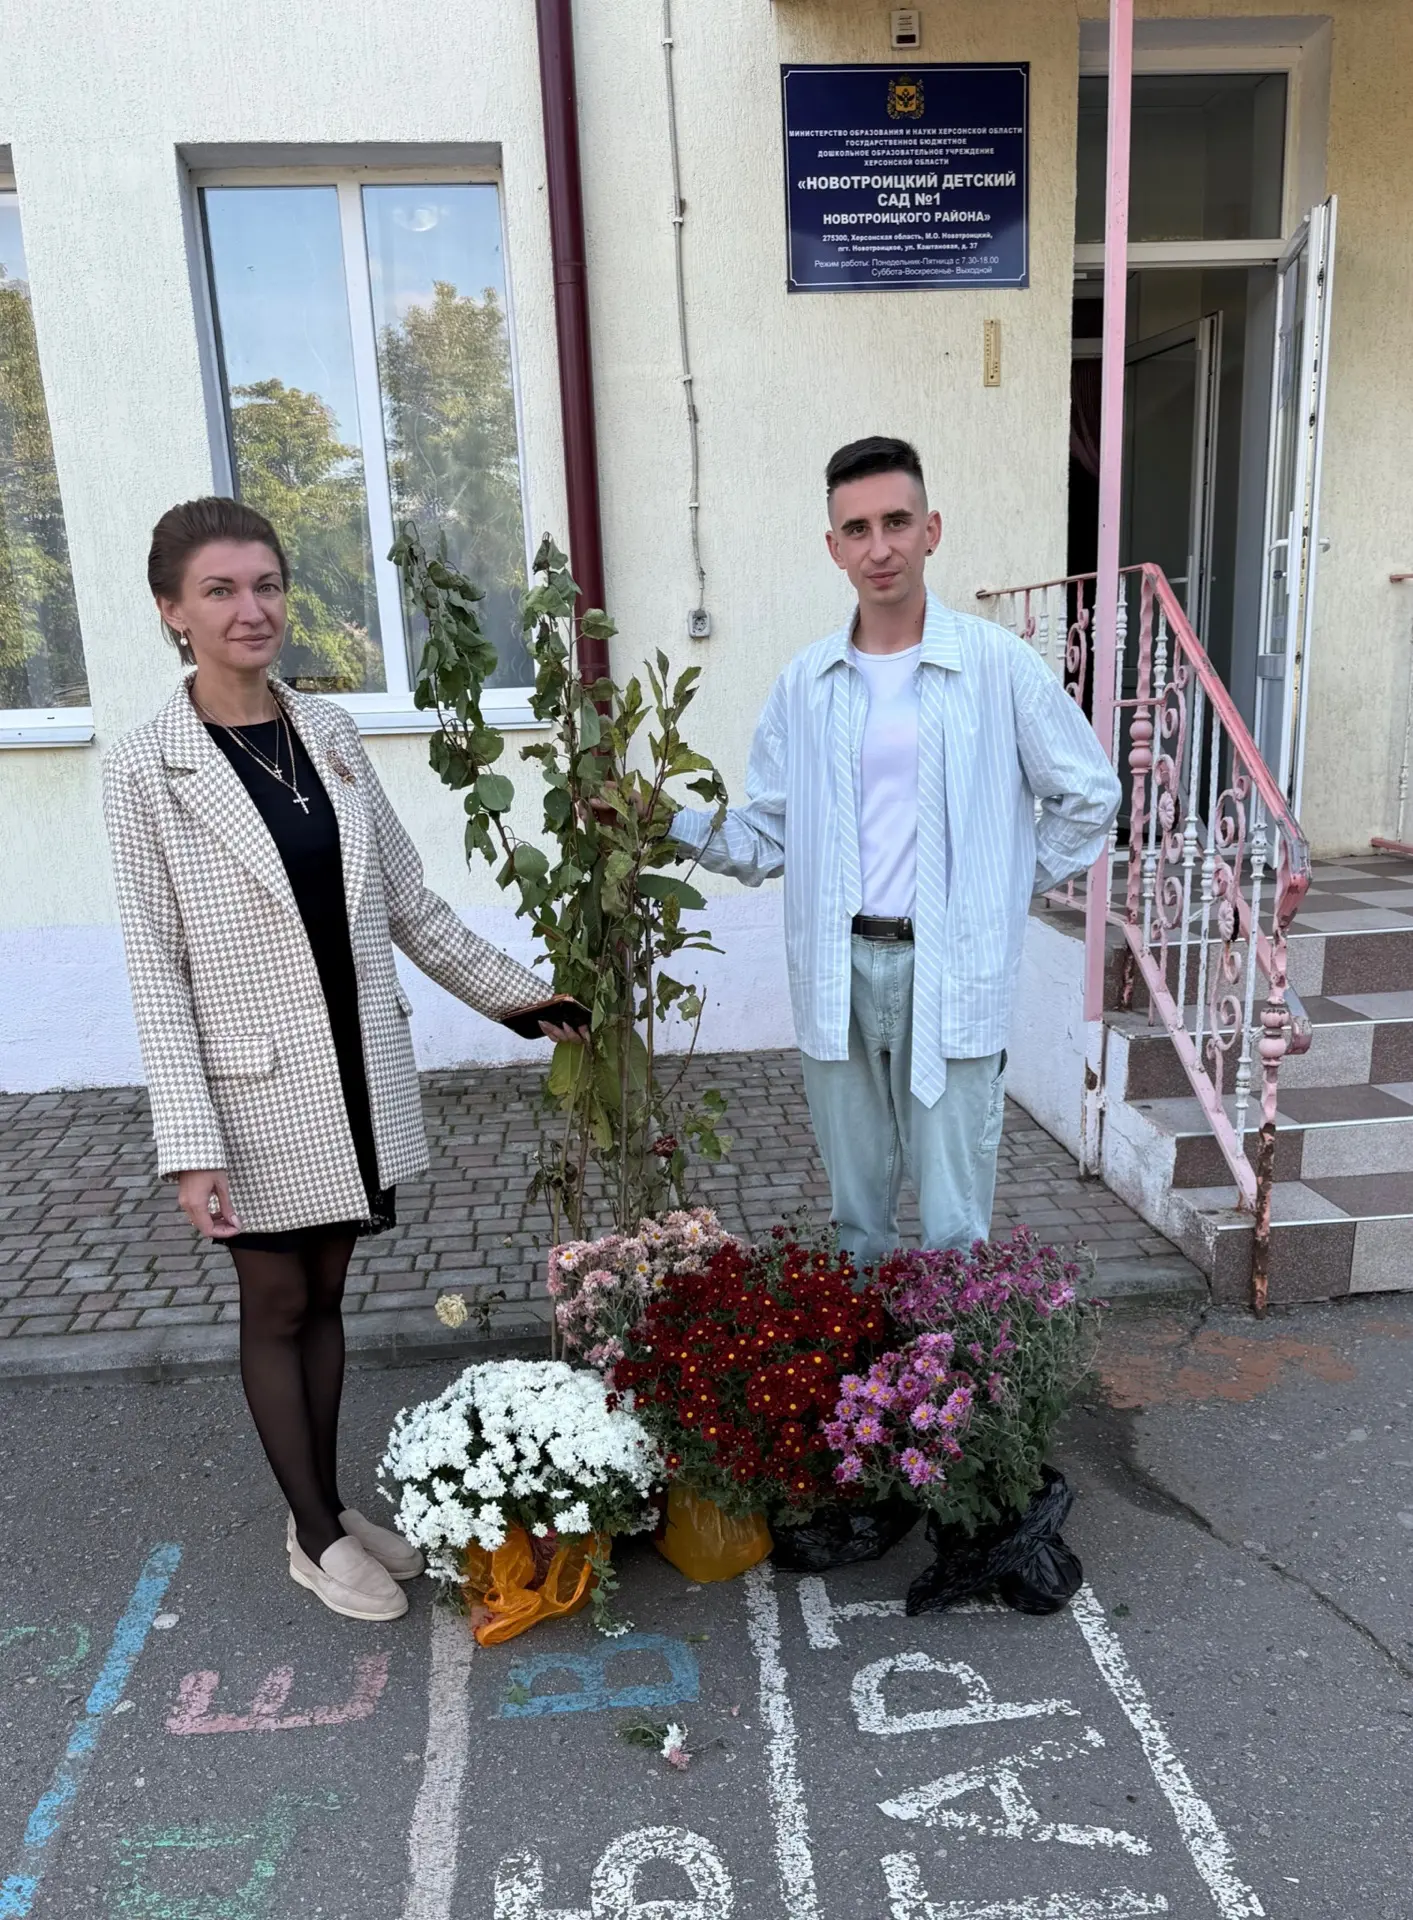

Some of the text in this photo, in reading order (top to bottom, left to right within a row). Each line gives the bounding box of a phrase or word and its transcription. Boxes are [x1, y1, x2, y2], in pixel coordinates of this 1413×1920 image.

[912, 128, 937, 136] НАУКИ
[938, 127, 987, 135] ХЕРСОНСКОЙ
[845, 138, 967, 147] ГОСУДАРСТВЕННОЕ БЮДЖЕТНОЕ
[817, 147, 995, 158] ДОШКОЛЬНОЕ ОБРАЗОВАТЕЛЬНОЕ УЧРЕЖДЕНИЕ
[864, 158, 913, 166] ХЕРСОНСКОЙ
[798, 171, 1016, 191] «НОВОТРОИЦКИЙ ДЕТСКИЙ
[877, 192, 941, 208] САД №1
[823, 210, 991, 225] НОВОТРОИЦКОГО РАЙОНА»
[822, 234, 850, 242] 275300,
[851, 234, 893, 242] Херсонская
[894, 233, 923, 241] область,
[942, 232, 993, 240] Новотроицкий,
[852, 245, 903, 253] Новотроицкое,
[961, 256, 999, 264] 7.30-18.00
[955, 267, 992, 275] Выходной
